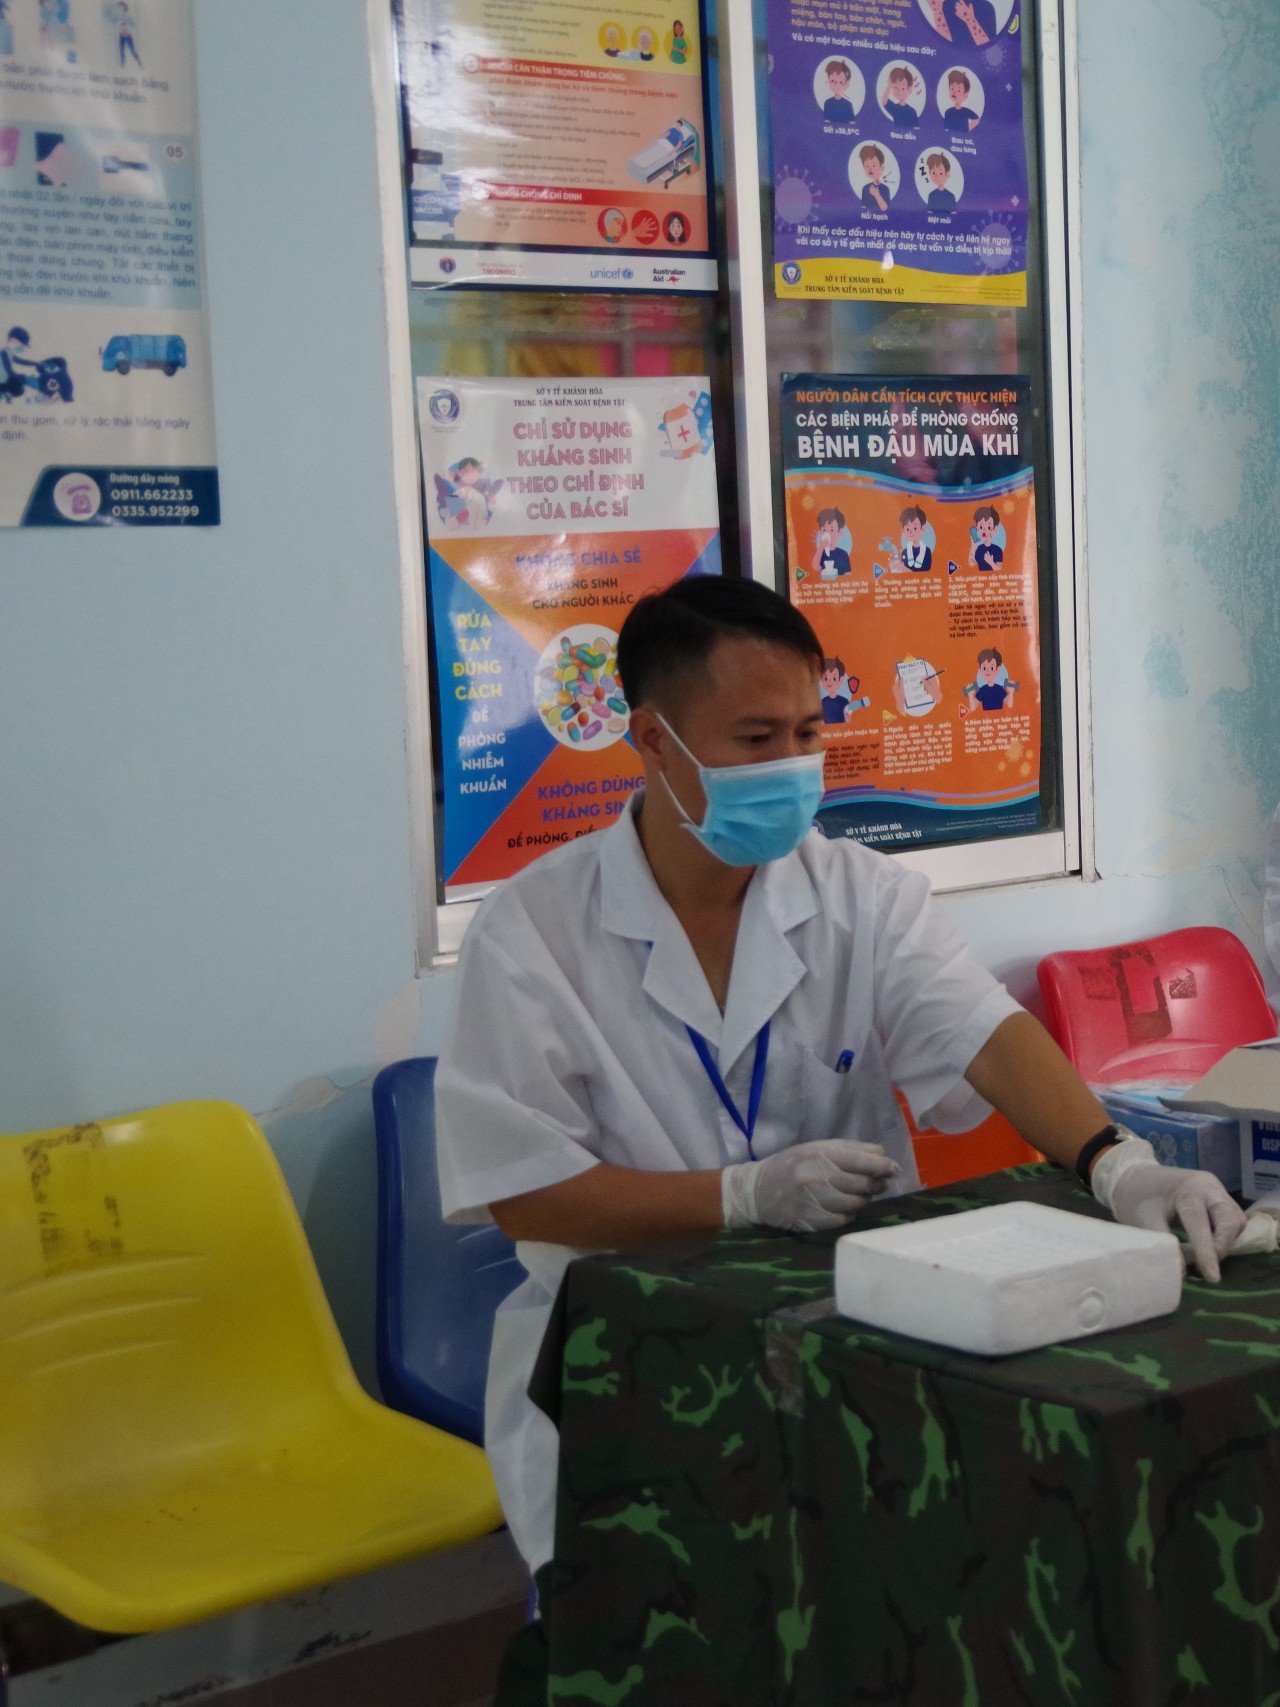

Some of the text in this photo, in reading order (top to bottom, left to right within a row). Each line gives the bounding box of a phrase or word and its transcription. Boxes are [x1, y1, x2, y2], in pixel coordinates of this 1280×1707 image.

[166, 145, 183, 158] 05
[797, 224, 810, 235] Khi
[831, 227, 847, 236] các
[848, 227, 864, 238] dấu
[926, 232, 945, 242] cách
[590, 267, 686, 279] unicef Australian
[652, 275, 664, 283] Aid
[804, 285, 826, 293] TRUNG
[513, 398, 537, 408] TRUNG
[795, 385, 1017, 406] NGƯỜI DÂN CẦN TÍCH CỰC THỰC HIỆN
[796, 406, 1019, 431] CÁC BIỆN PHÁP ĐỂ PHÒNG CHỐNG
[513, 416, 633, 444] CHỈ SỬ DỤNG
[517, 443, 632, 467] KHÁNG SINH
[797, 425, 1019, 466] BỆNH ĐẬU MÙA KHỈ
[506, 469, 646, 496] THEO CHỈ ĐỊNH
[110, 488, 194, 501] 0911.662233
[526, 495, 630, 520] CỦA BÁC SĨ
[580, 550, 620, 566] CHIA
[590, 577, 619, 590] SINH
[531, 591, 635, 610] CHO NGƯỜI KHÁC
[456, 608, 492, 629] RỬA
[458, 636, 493, 654] TAY
[453, 656, 502, 677] ĐÚNG
[455, 681, 503, 701] CÁCH
[458, 731, 507, 748] PHÒNG
[461, 751, 506, 771] NHIỄM
[459, 773, 508, 795] KHUẨN
[536, 774, 649, 800] KHÔNG DÙNG
[542, 800, 601, 822] KHÁNG
[507, 830, 523, 848] ĐỂ
